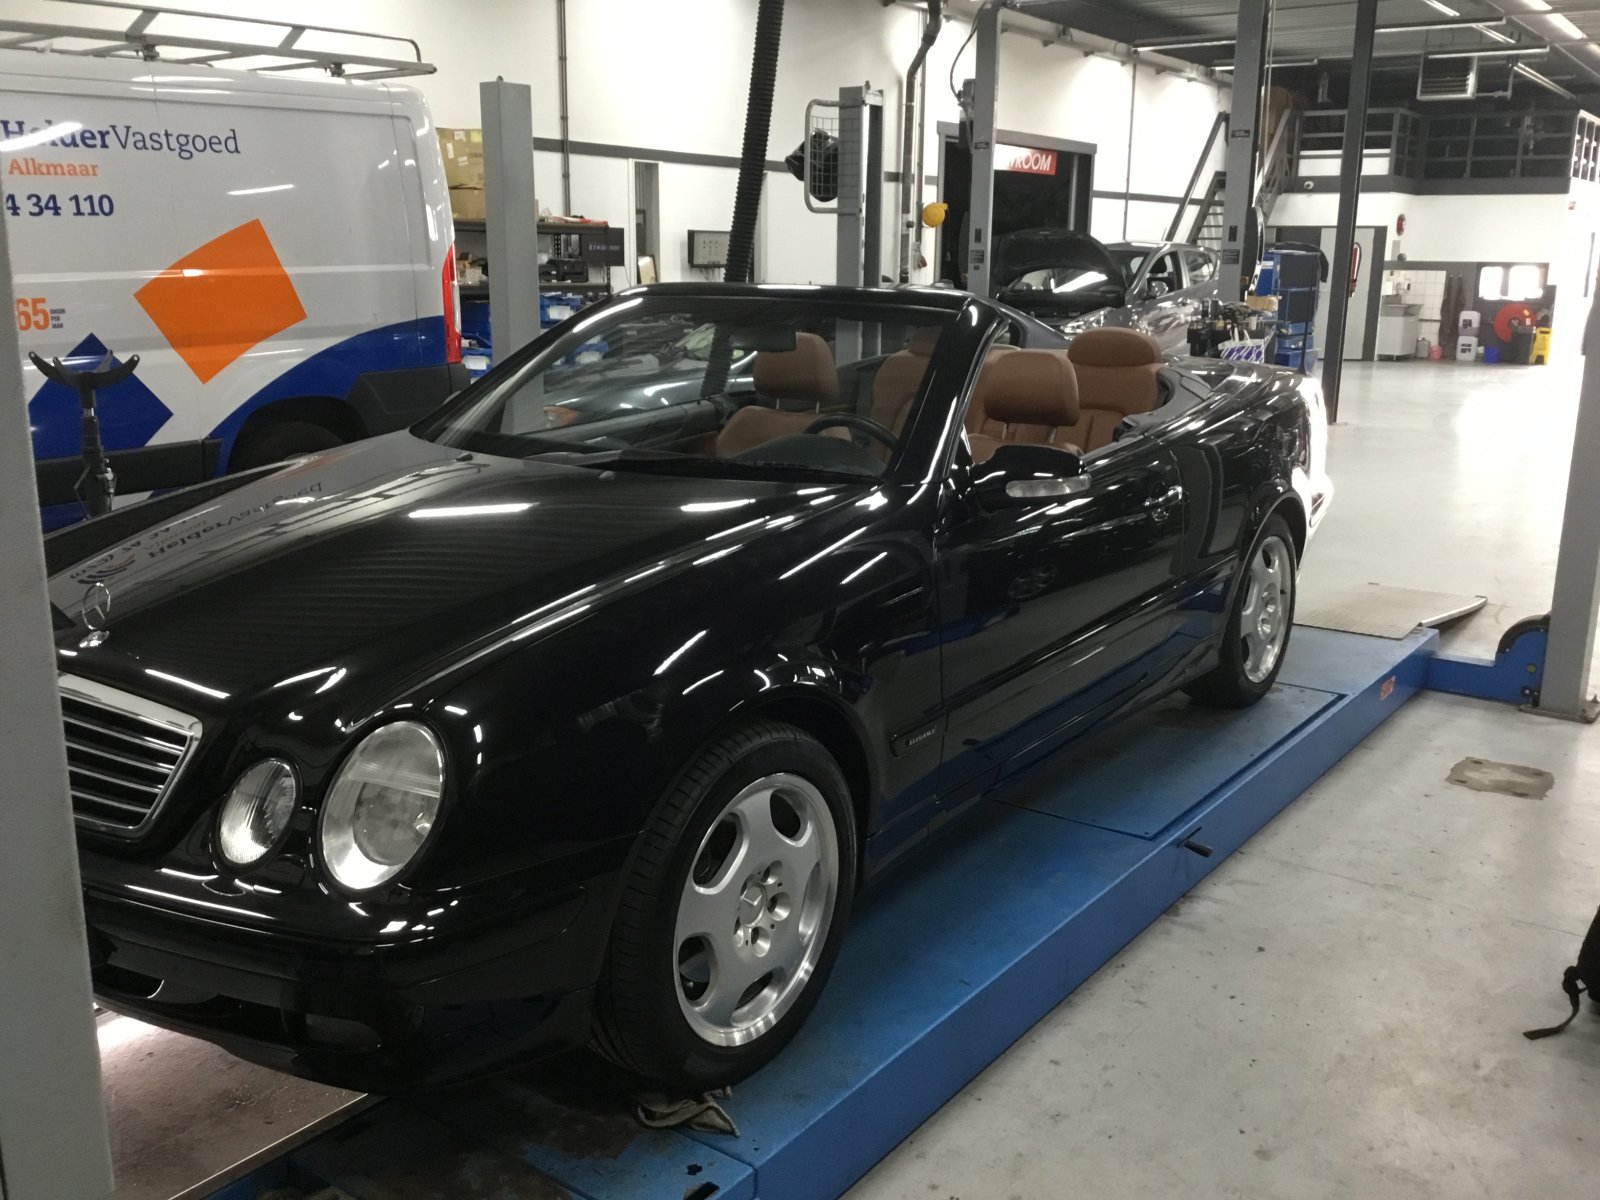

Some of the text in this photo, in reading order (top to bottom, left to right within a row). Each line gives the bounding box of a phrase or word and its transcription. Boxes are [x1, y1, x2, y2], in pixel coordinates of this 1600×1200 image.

[0, 119, 241, 160] HderVastgoed
[8, 158, 99, 177] Alkmaar
[26, 193, 62, 217] 34
[68, 193, 114, 217] 110
[15, 297, 50, 331] 65
